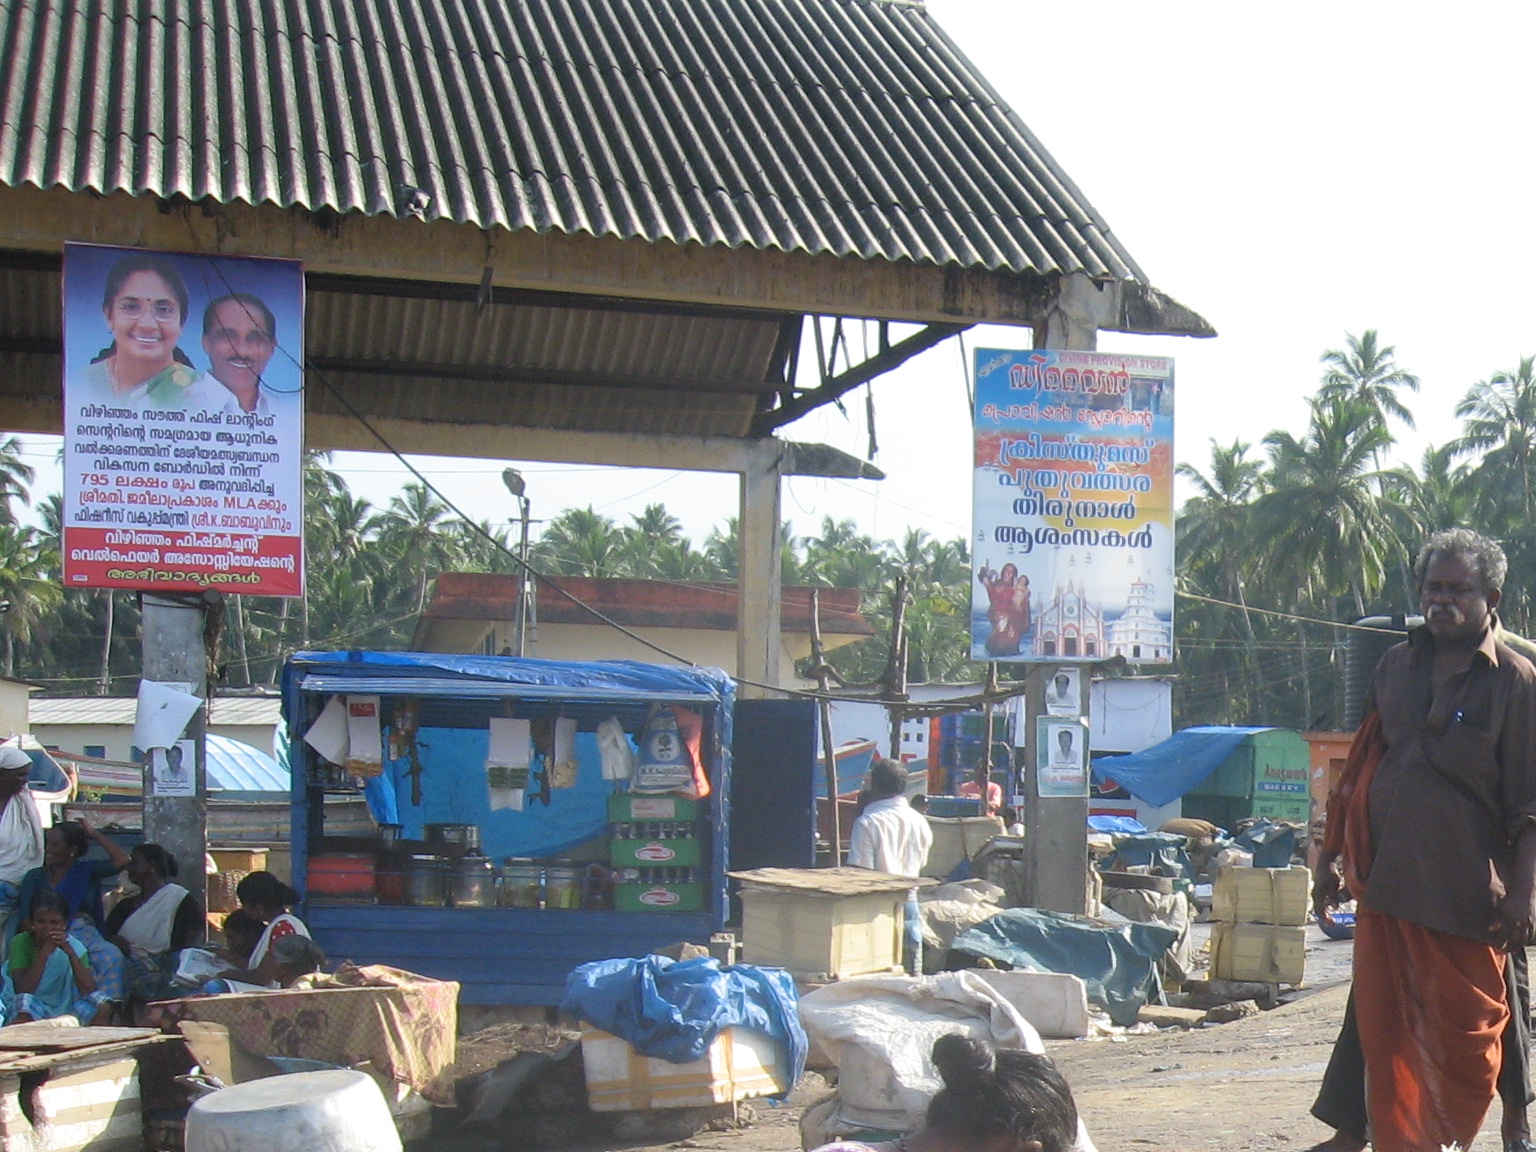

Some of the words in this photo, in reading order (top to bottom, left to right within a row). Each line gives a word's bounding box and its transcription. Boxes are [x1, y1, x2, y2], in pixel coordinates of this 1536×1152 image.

[80, 403, 138, 420] വിഴിഞ്ഞം
[190, 409, 224, 425] ഫിഷ്
[215, 430, 278, 447] ആധുനിക
[94, 456, 150, 472] വികസന
[153, 460, 225, 477] ബോർഡിൽ
[230, 463, 263, 478] നിന്ന്
[80, 472, 110, 486] 795
[115, 475, 168, 489] ലക്ഷം
[172, 478, 196, 492] രൂപ
[998, 468, 1152, 498] പുതുവത്സര
[1012, 490, 1136, 527] തിരുനാൾ
[105, 528, 172, 547] വിഴിഞ്ഞം
[994, 523, 1153, 554] ആശംസകൾ
[106, 567, 261, 587] അഭിവാദ്യങ്ങൾ
